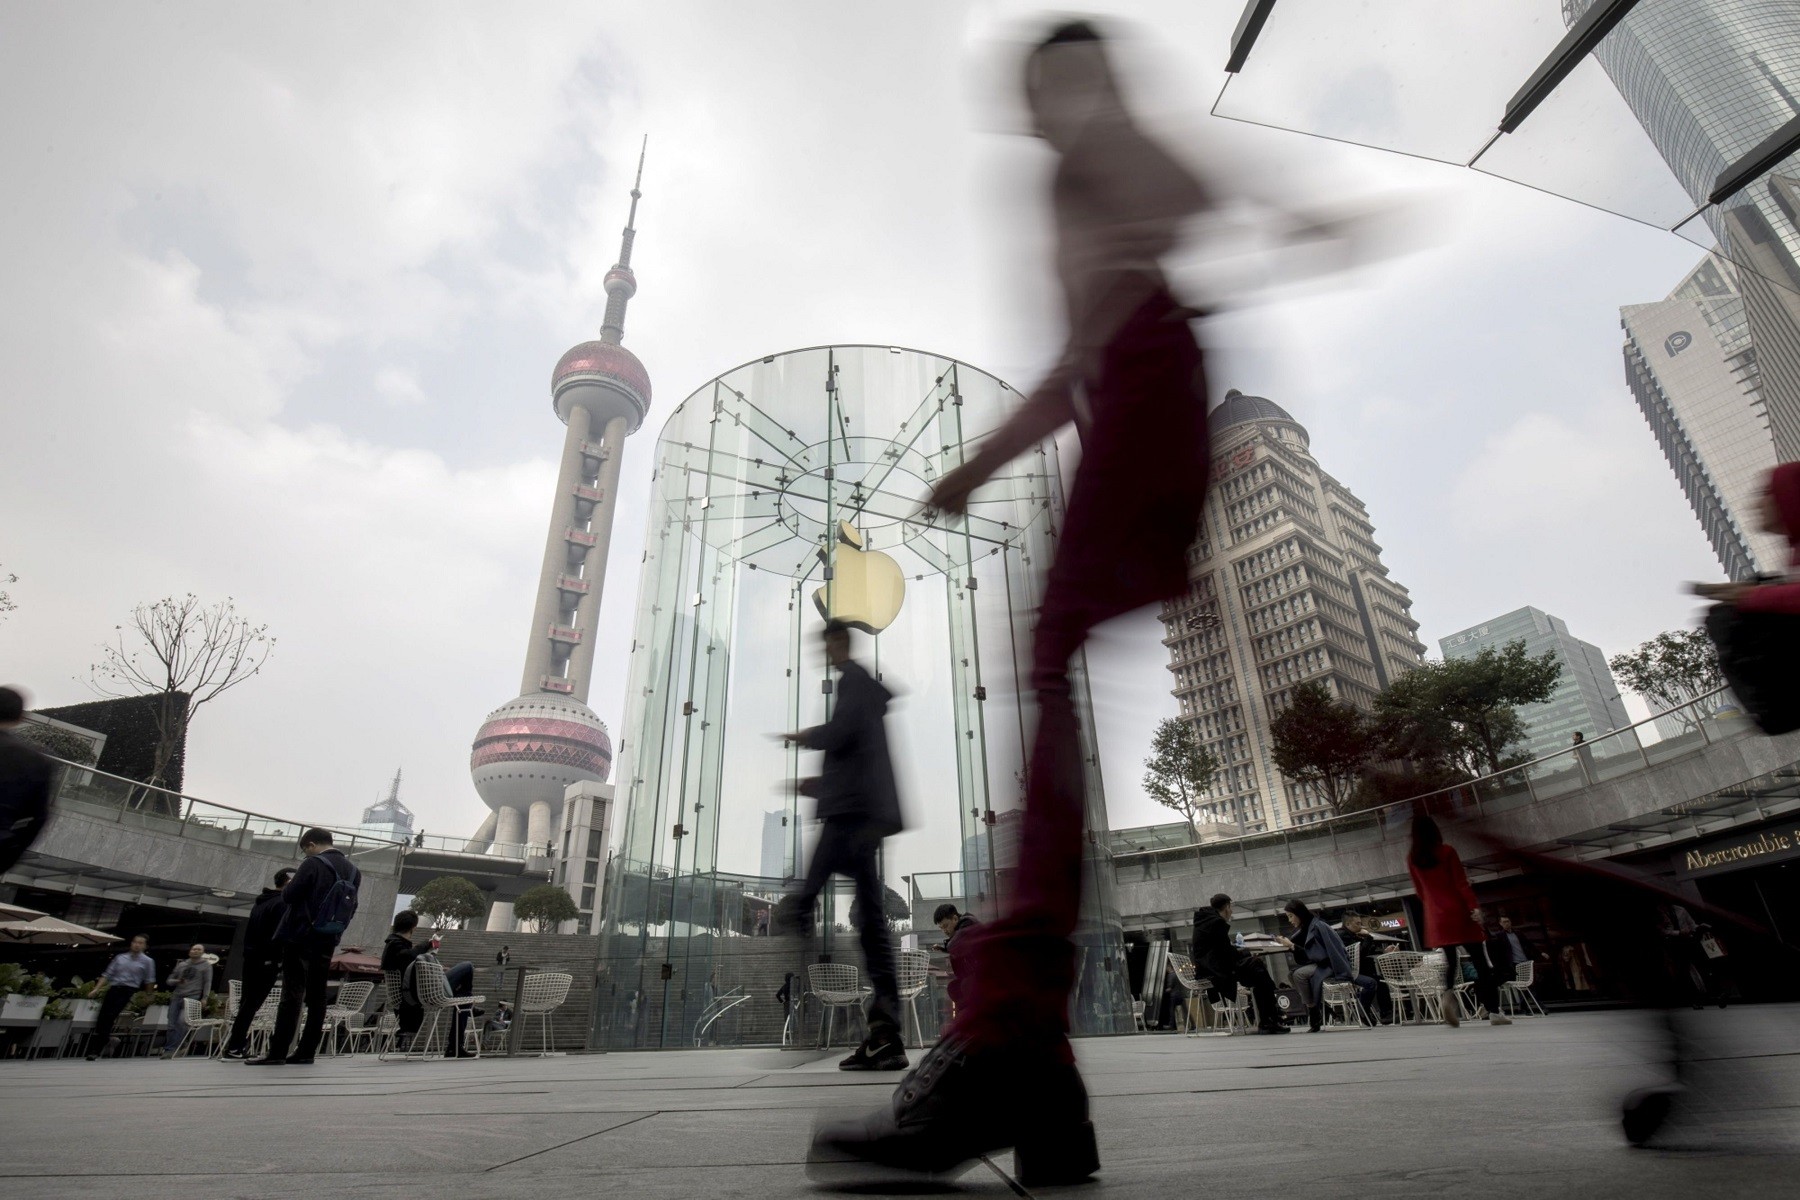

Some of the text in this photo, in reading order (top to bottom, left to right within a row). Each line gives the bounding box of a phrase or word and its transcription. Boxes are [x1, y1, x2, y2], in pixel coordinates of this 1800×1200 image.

[1446, 626, 1490, 649] 汇亚大厦
[1686, 833, 1791, 871] Abercrombie
